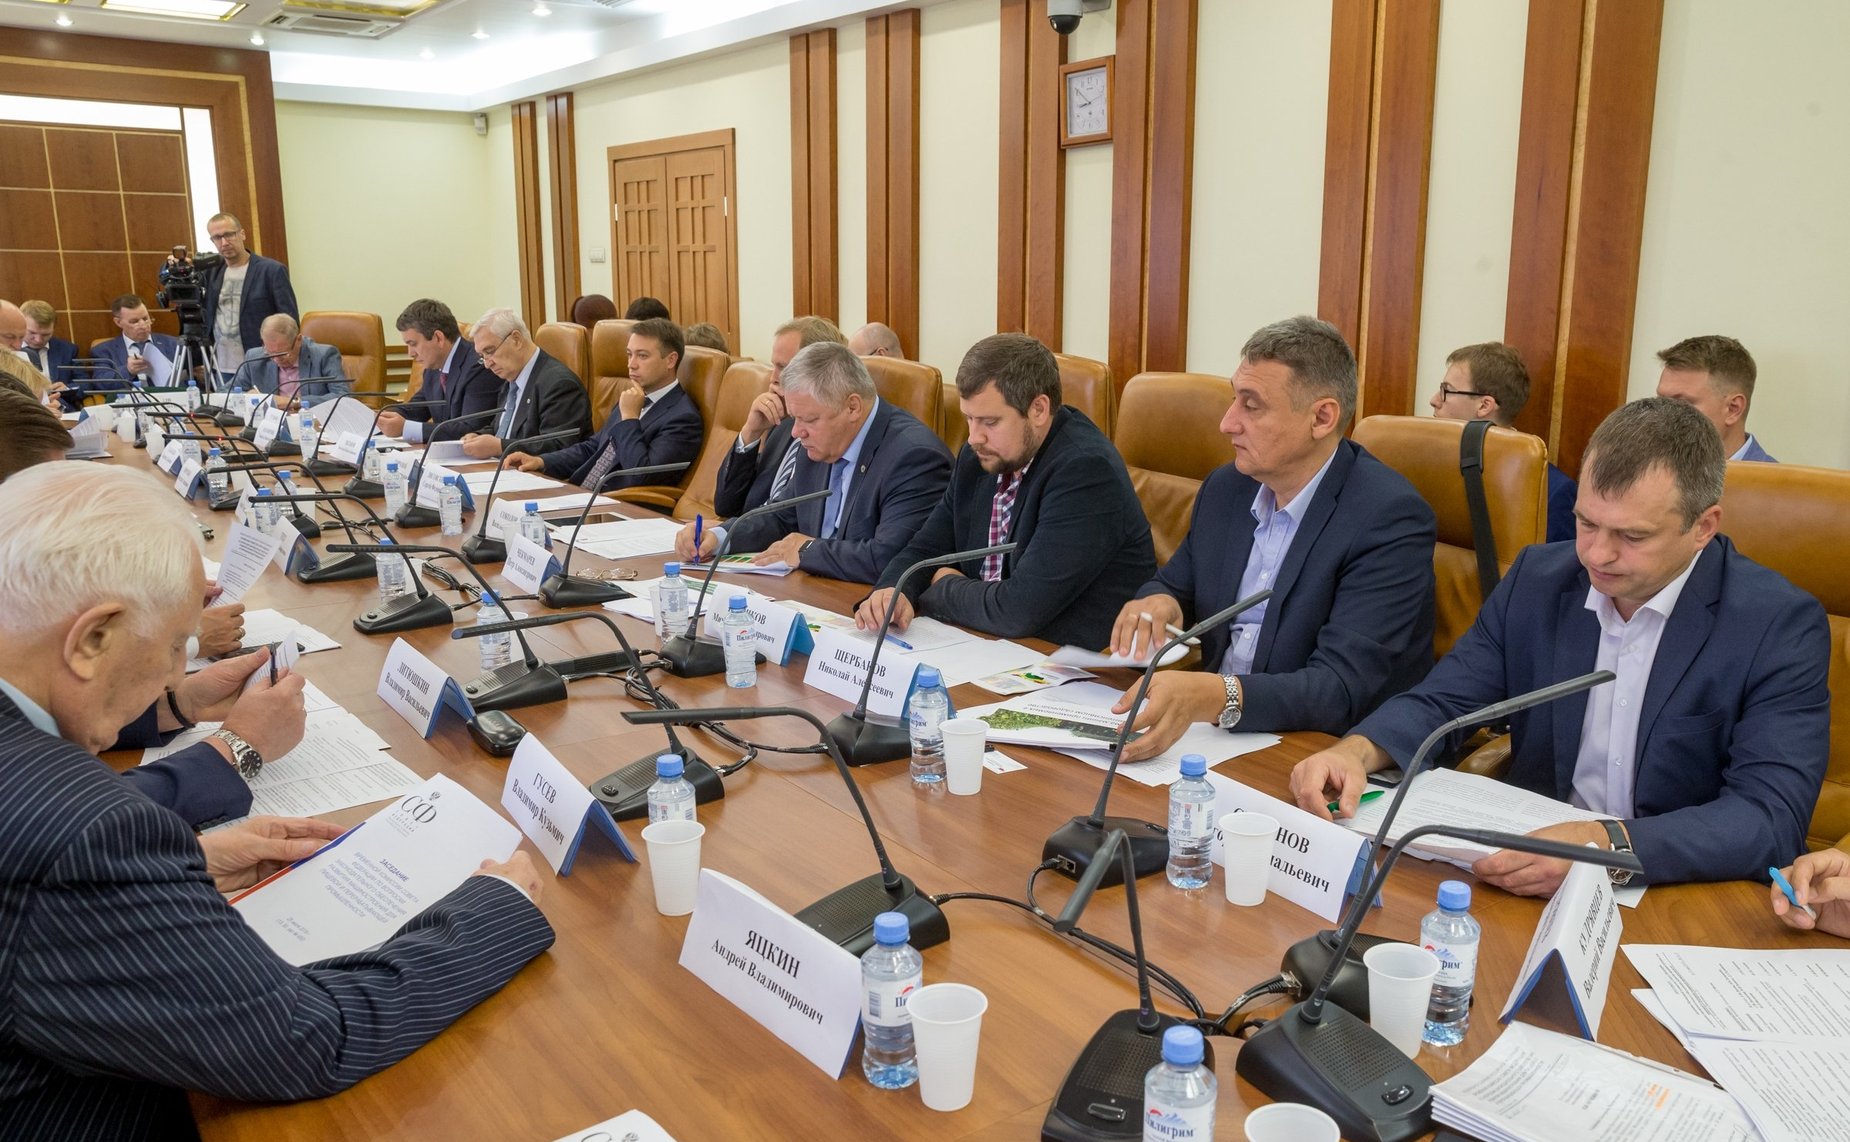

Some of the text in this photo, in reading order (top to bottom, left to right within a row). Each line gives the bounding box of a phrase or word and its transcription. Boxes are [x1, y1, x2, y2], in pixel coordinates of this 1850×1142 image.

[818, 661, 894, 699] Николай Алесеевич
[532, 772, 557, 804] ГУСЕВ
[401, 795, 437, 824] СФ
[511, 779, 565, 846] Владимир Кузьмич
[379, 858, 410, 882] ЗАСЕДАНИЕ
[744, 929, 800, 979] ЯЦКИН
[711, 938, 824, 1026] Андрей Владимирович
